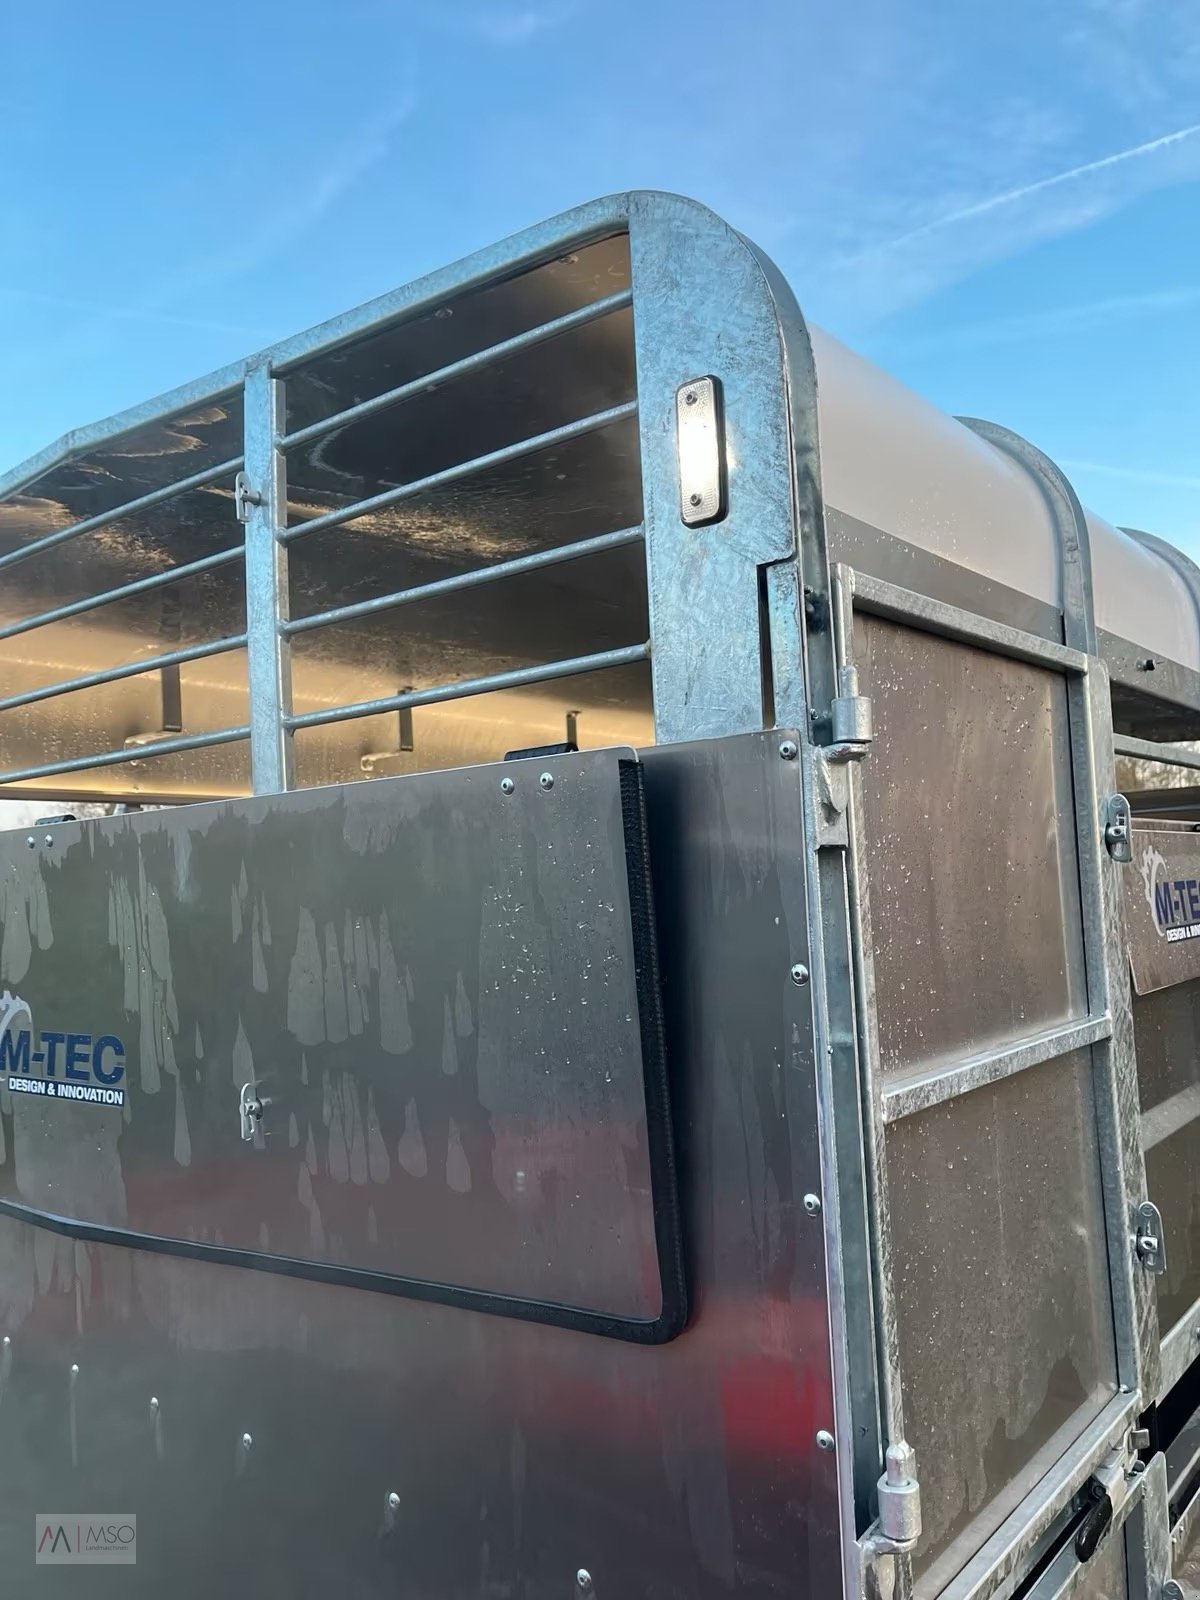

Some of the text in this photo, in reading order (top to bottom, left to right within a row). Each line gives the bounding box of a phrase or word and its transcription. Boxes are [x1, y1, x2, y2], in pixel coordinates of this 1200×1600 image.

[1155, 880, 1200, 924] M-TE
[1166, 926, 1187, 942] DESIGN
[0, 1029, 125, 1085] M-TEC
[9, 1077, 123, 1105] DESIGN & INNOVATION
